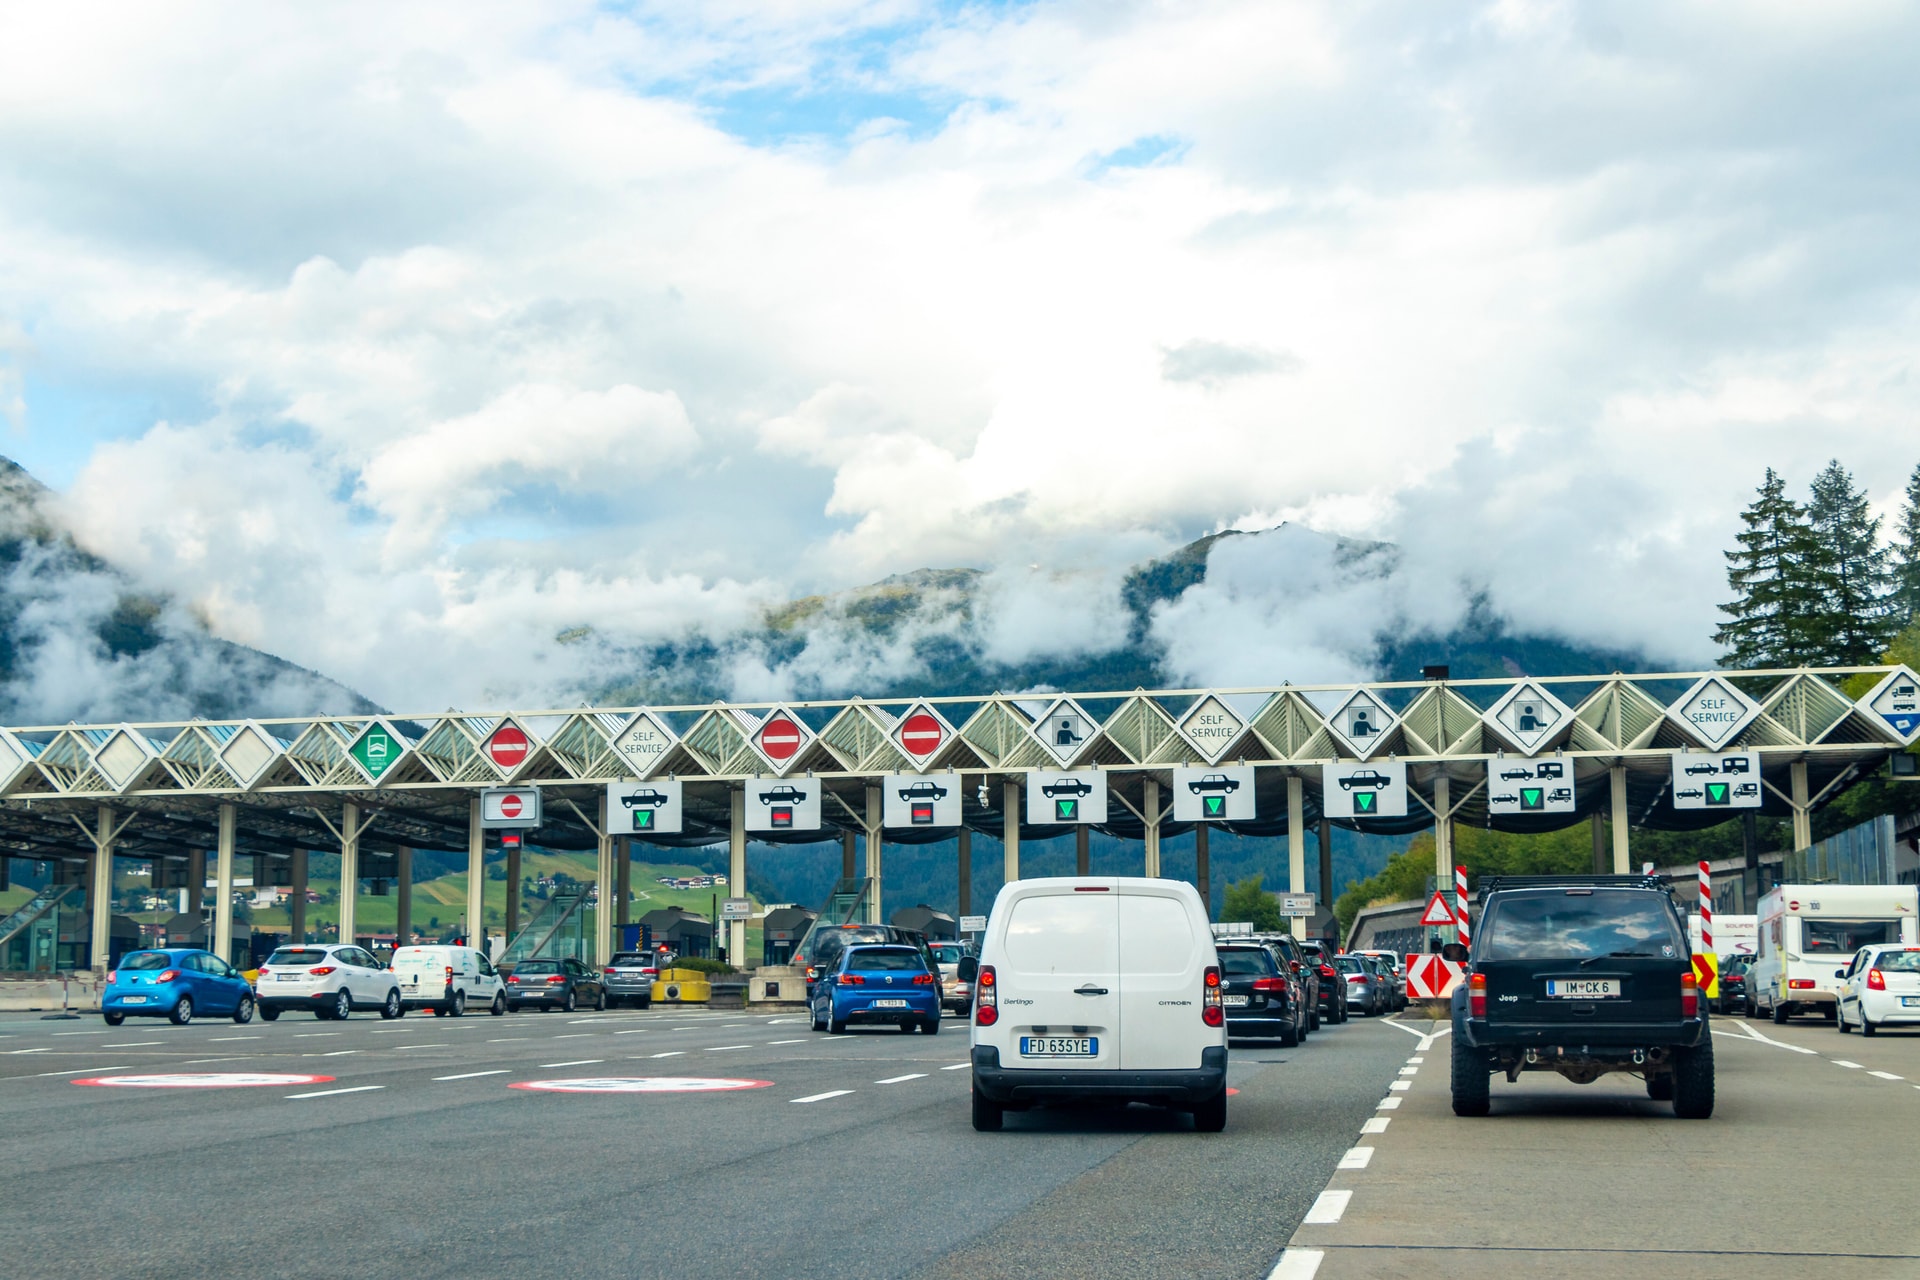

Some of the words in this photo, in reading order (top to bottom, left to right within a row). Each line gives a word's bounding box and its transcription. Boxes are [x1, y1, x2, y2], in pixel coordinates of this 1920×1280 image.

[1700, 699, 1726, 709] SELF
[1200, 715, 1224, 725] SELF
[1692, 712, 1736, 722] SERVICE
[633, 732, 655, 741] SELF
[1192, 727, 1233, 738] SERVICE
[625, 744, 663, 754] SERVICE
[1566, 982, 1578, 993] IM
[1585, 982, 1600, 993] CK
[1602, 982, 1609, 993] 6
[1003, 998, 1034, 1006] Berlingo
[1498, 994, 1519, 1003] Jeep
[1029, 1039, 1045, 1053] FD
[1049, 1039, 1089, 1053] 635YE
